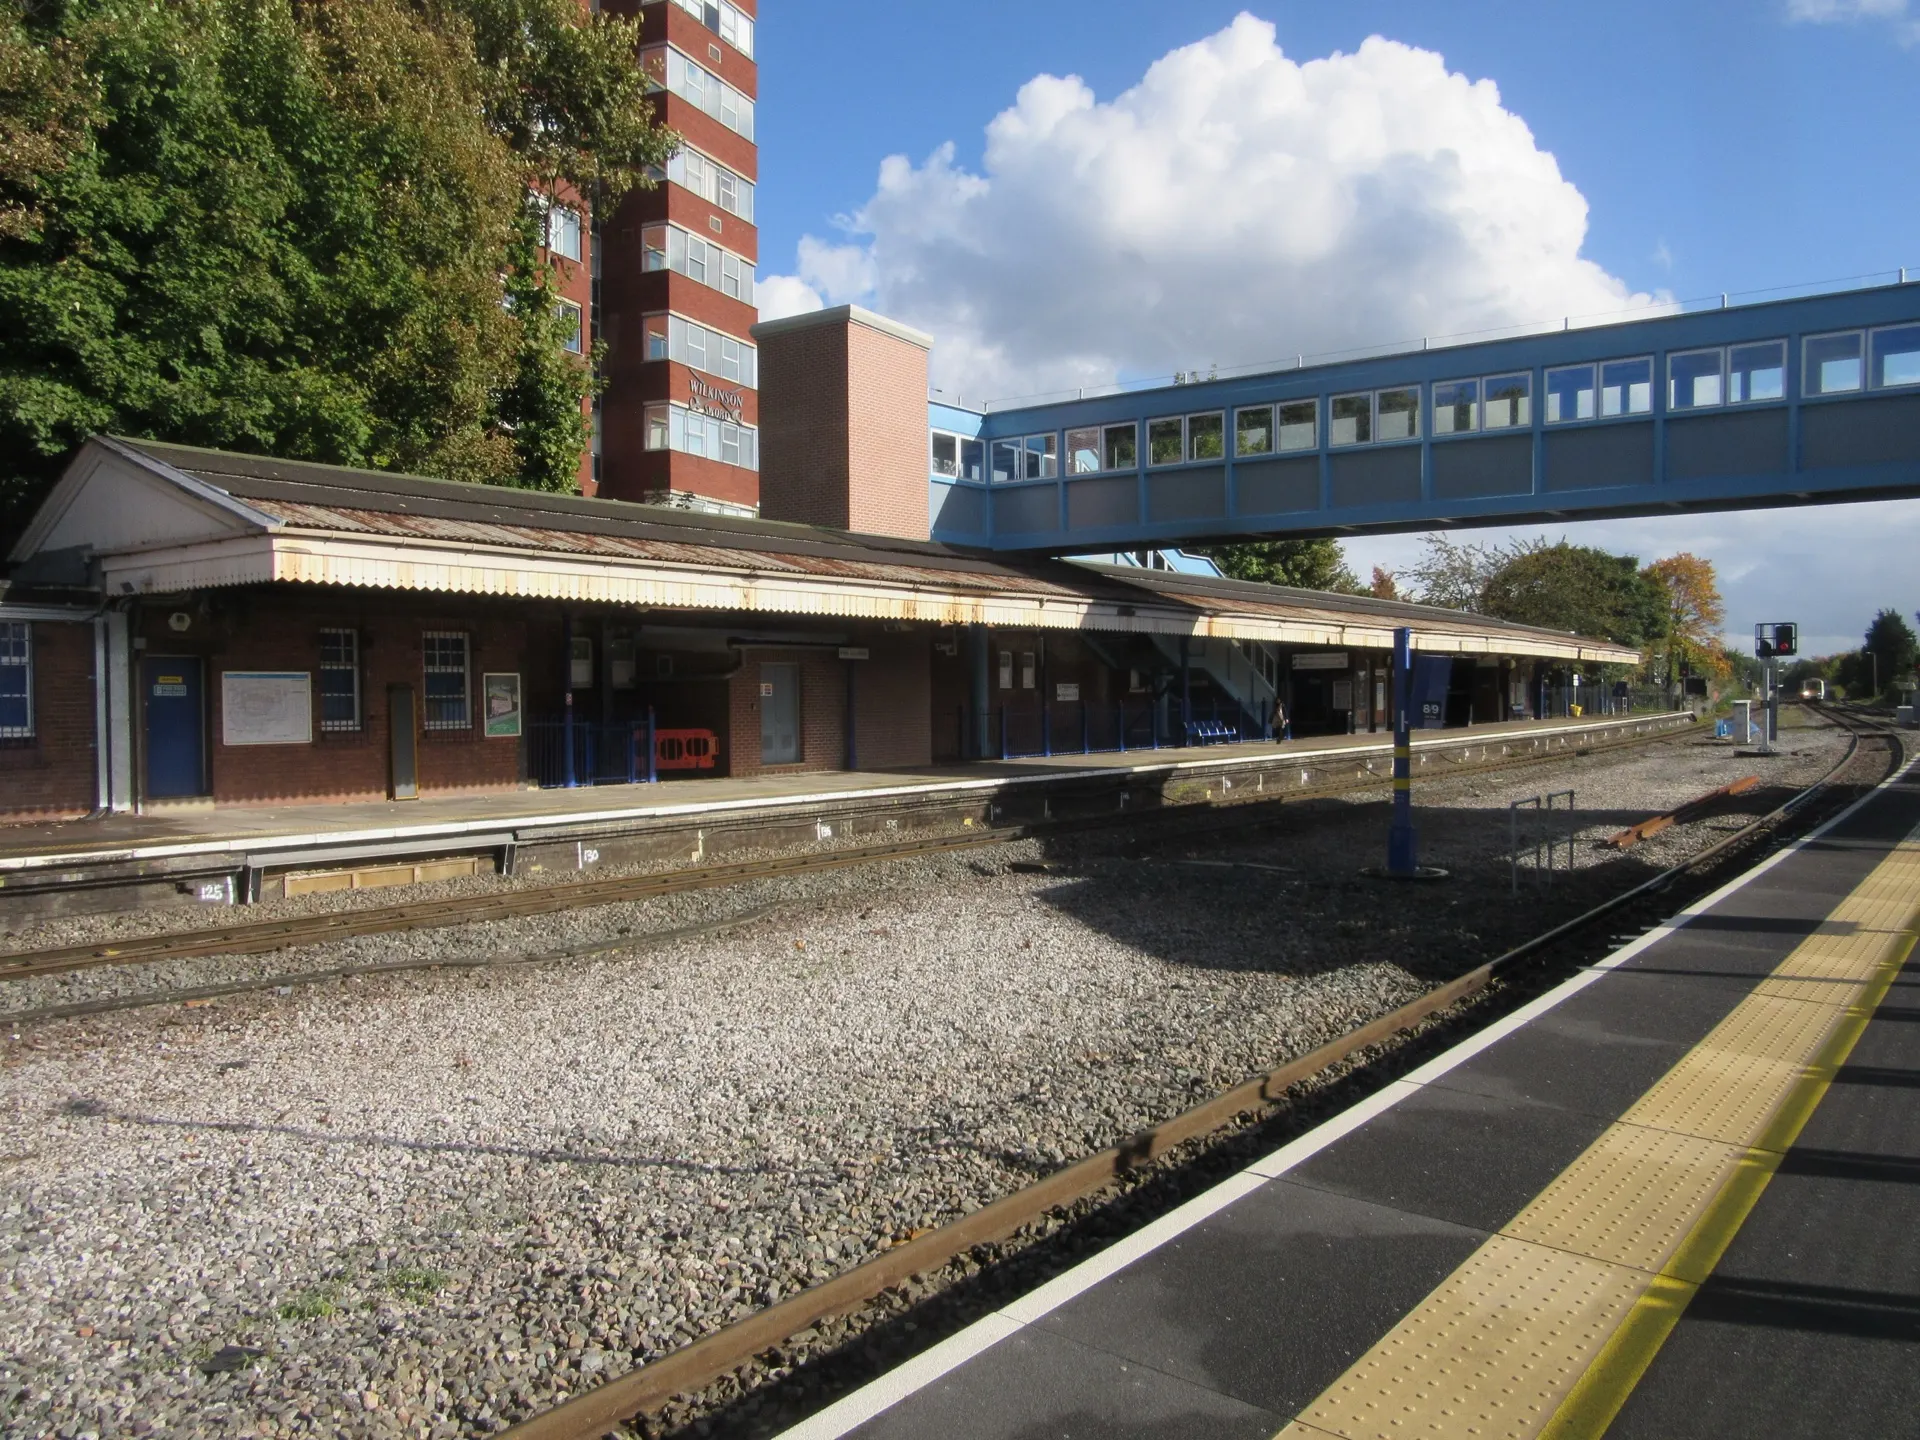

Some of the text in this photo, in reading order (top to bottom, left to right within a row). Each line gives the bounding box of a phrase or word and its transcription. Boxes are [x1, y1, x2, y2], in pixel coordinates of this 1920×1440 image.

[689, 380, 744, 408] WILKINSON
[704, 405, 731, 421] SWORD
[584, 849, 599, 863] 130
[201, 884, 223, 900] 125
